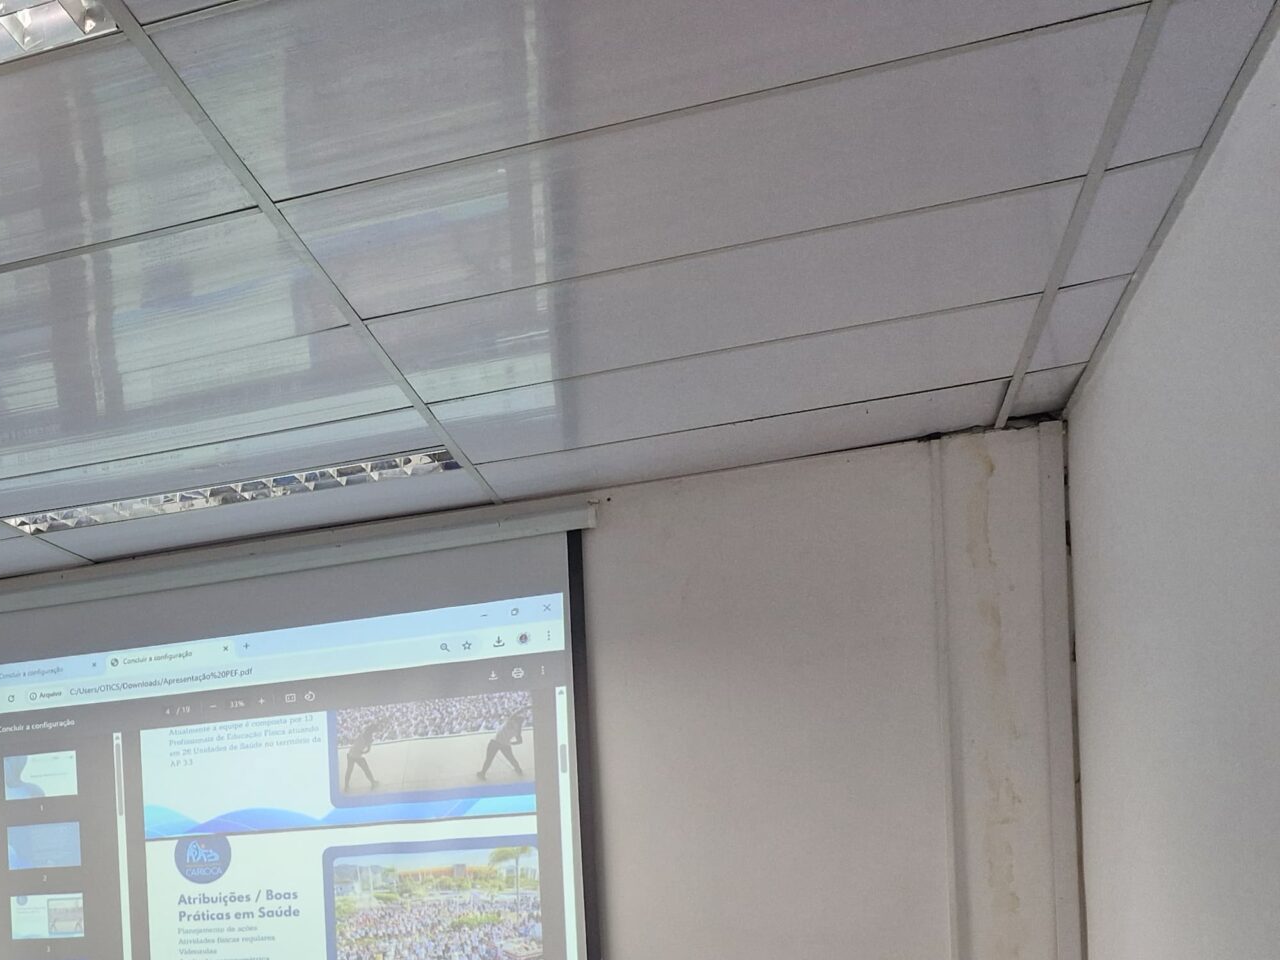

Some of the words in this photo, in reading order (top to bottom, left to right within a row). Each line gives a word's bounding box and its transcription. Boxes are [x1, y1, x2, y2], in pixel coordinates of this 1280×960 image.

[31, 718, 76, 730] configuração
[177, 890, 251, 907] Atribuições
[266, 889, 299, 901] Boas
[178, 910, 231, 922] Práticas
[234, 911, 254, 920] em
[258, 905, 300, 919] Saúde
